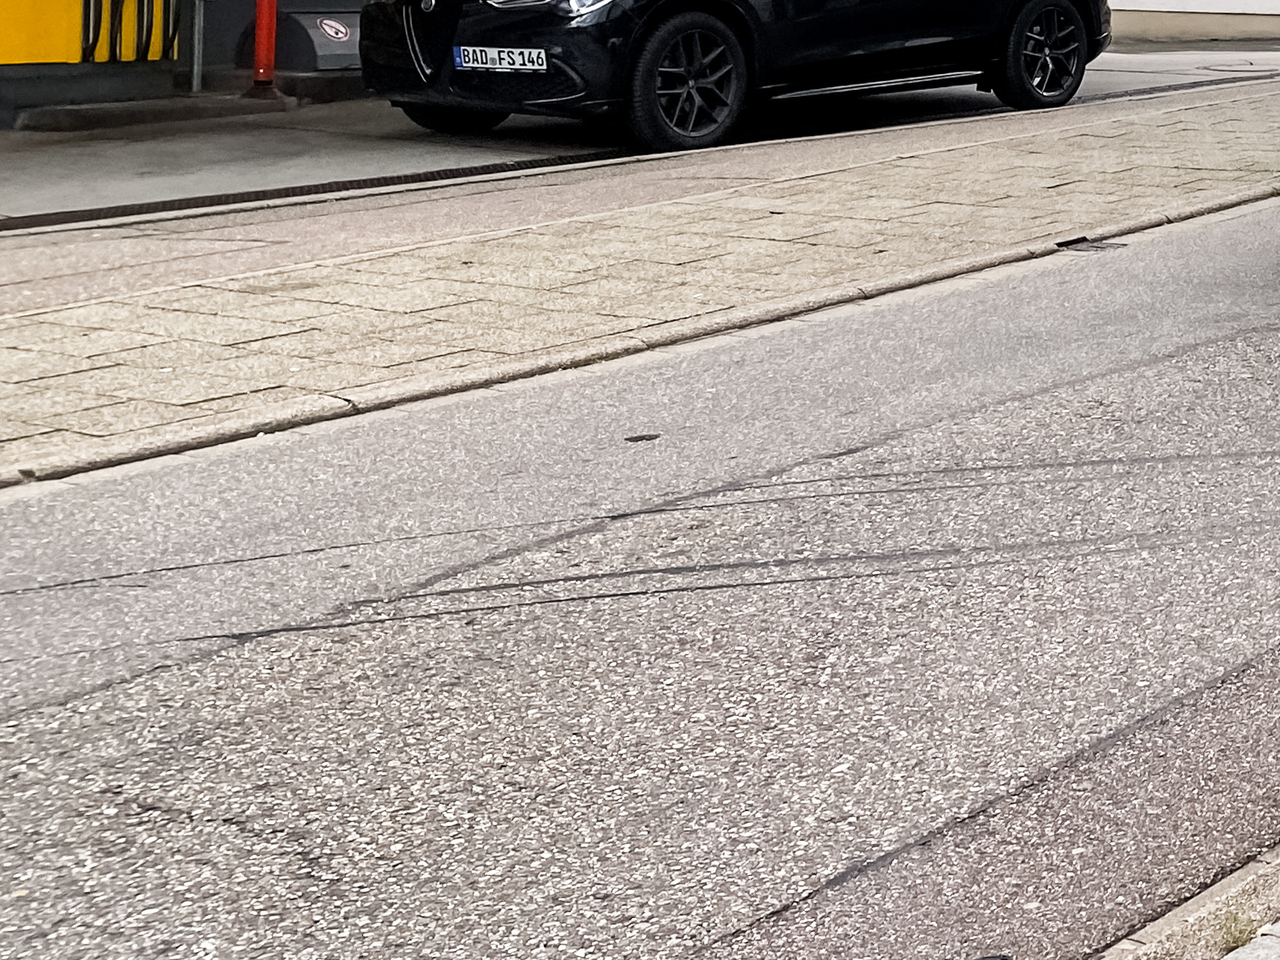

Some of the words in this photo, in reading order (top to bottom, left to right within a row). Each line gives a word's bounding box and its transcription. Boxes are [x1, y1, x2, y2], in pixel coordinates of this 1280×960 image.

[462, 48, 488, 65] BAD
[497, 50, 516, 66] FS
[518, 51, 545, 67] 146
